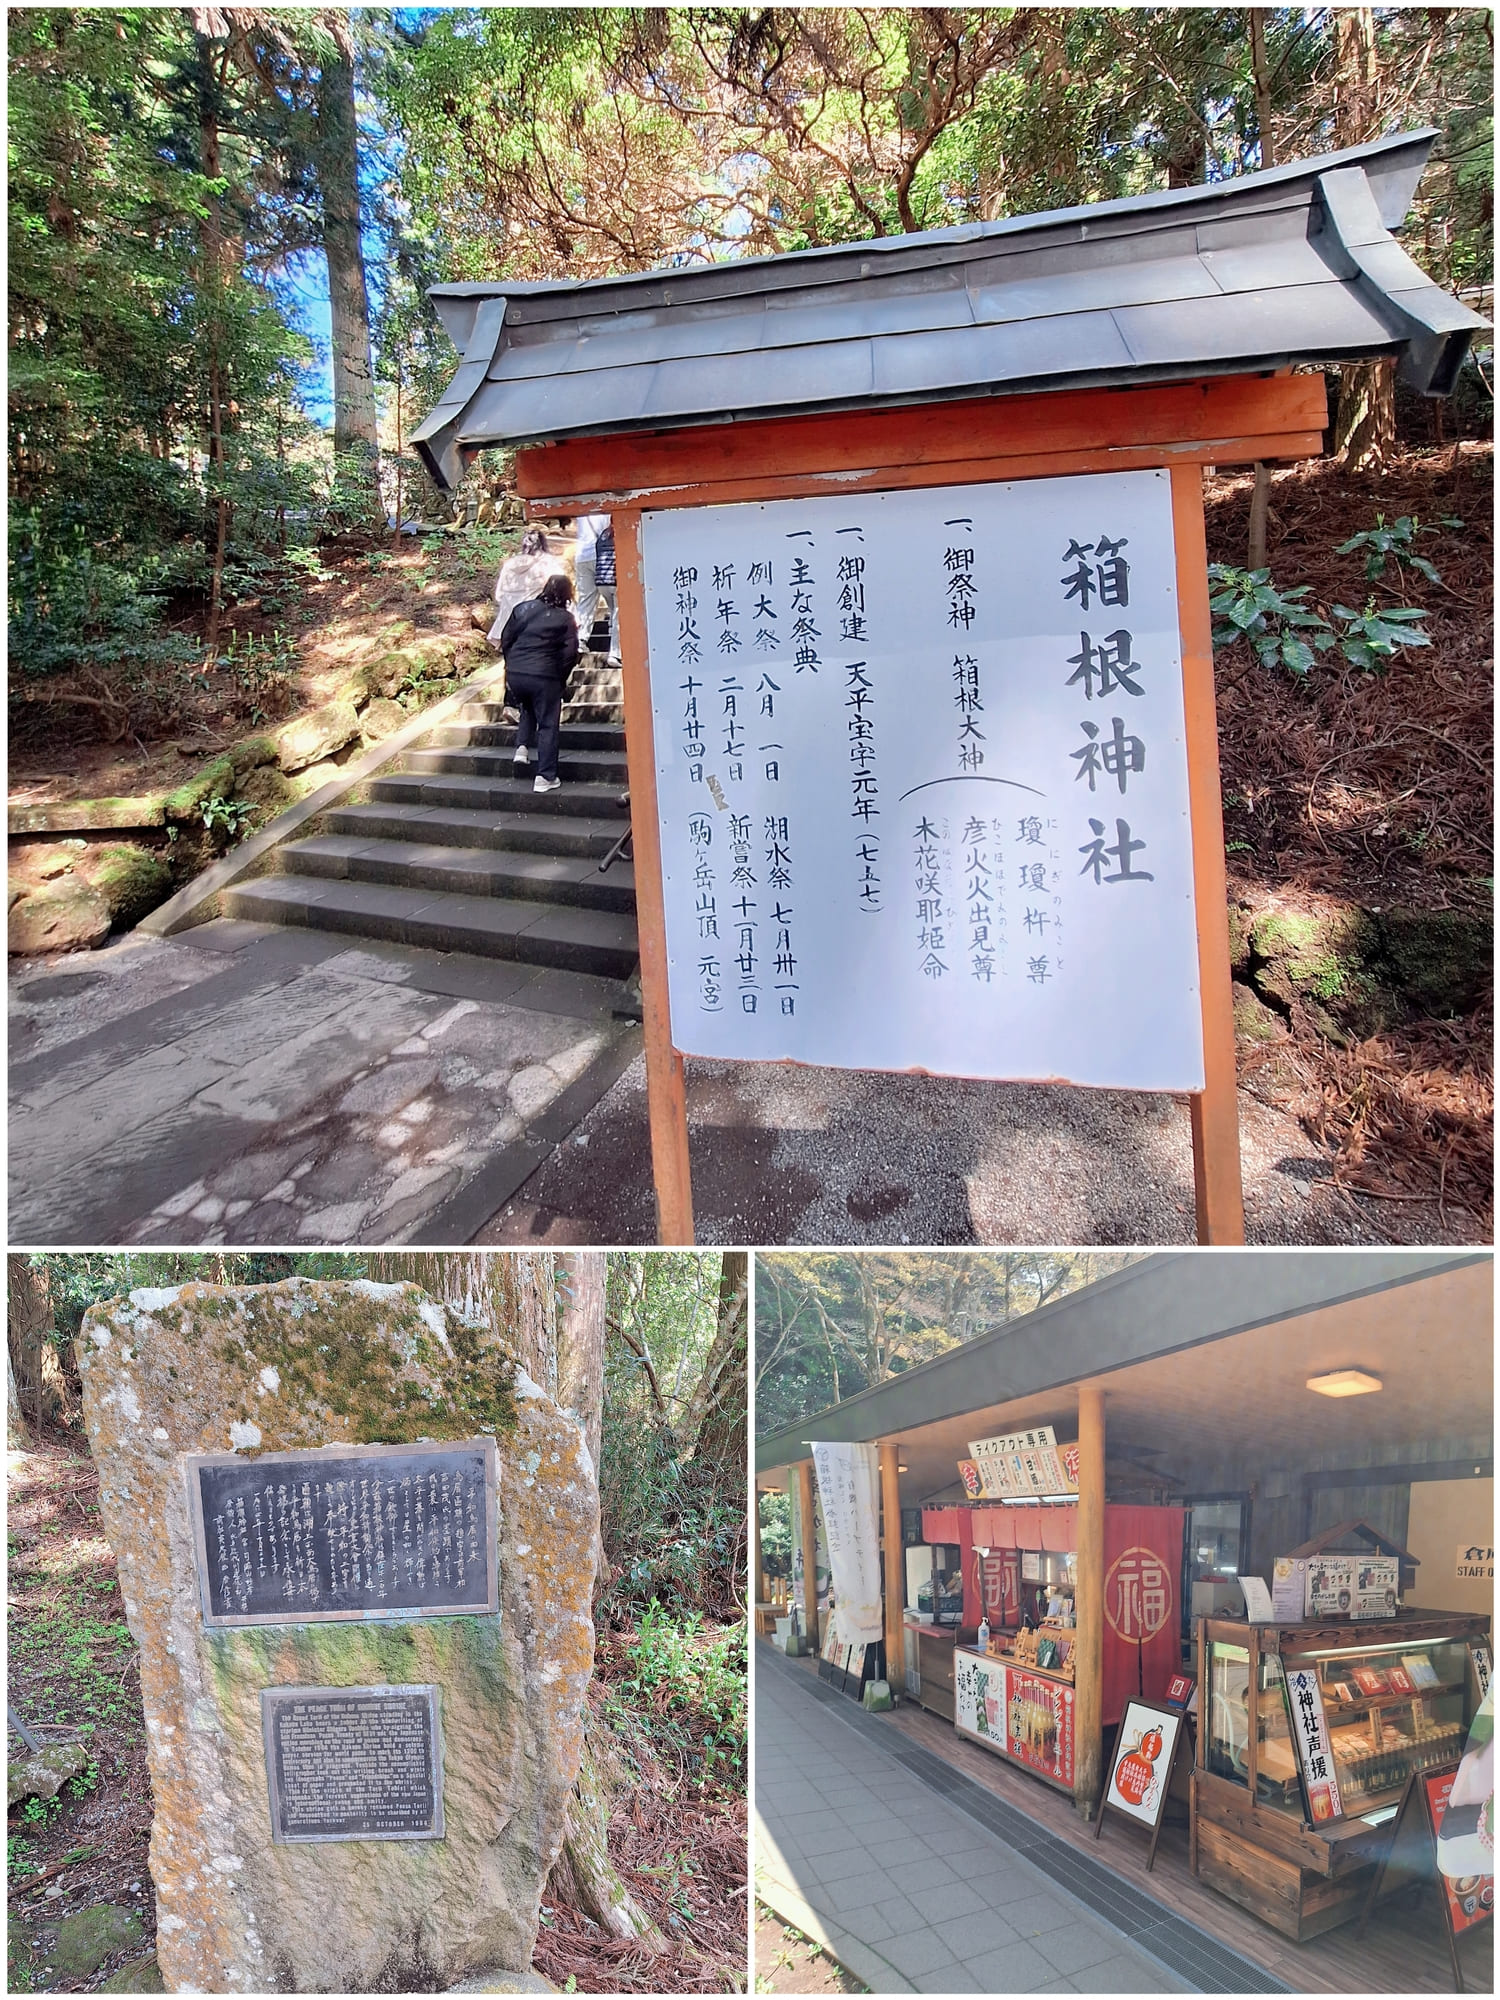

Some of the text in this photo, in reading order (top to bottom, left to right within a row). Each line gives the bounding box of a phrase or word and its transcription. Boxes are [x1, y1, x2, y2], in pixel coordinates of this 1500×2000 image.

[1060, 535, 1154, 885] 箱根神社
[975, 1430, 1048, 1456] テイクアウト専用
[1117, 1560, 1165, 1633] 福
[1457, 1566, 1486, 1577] STAFF
[1298, 1690, 1329, 1780] 神社声援
